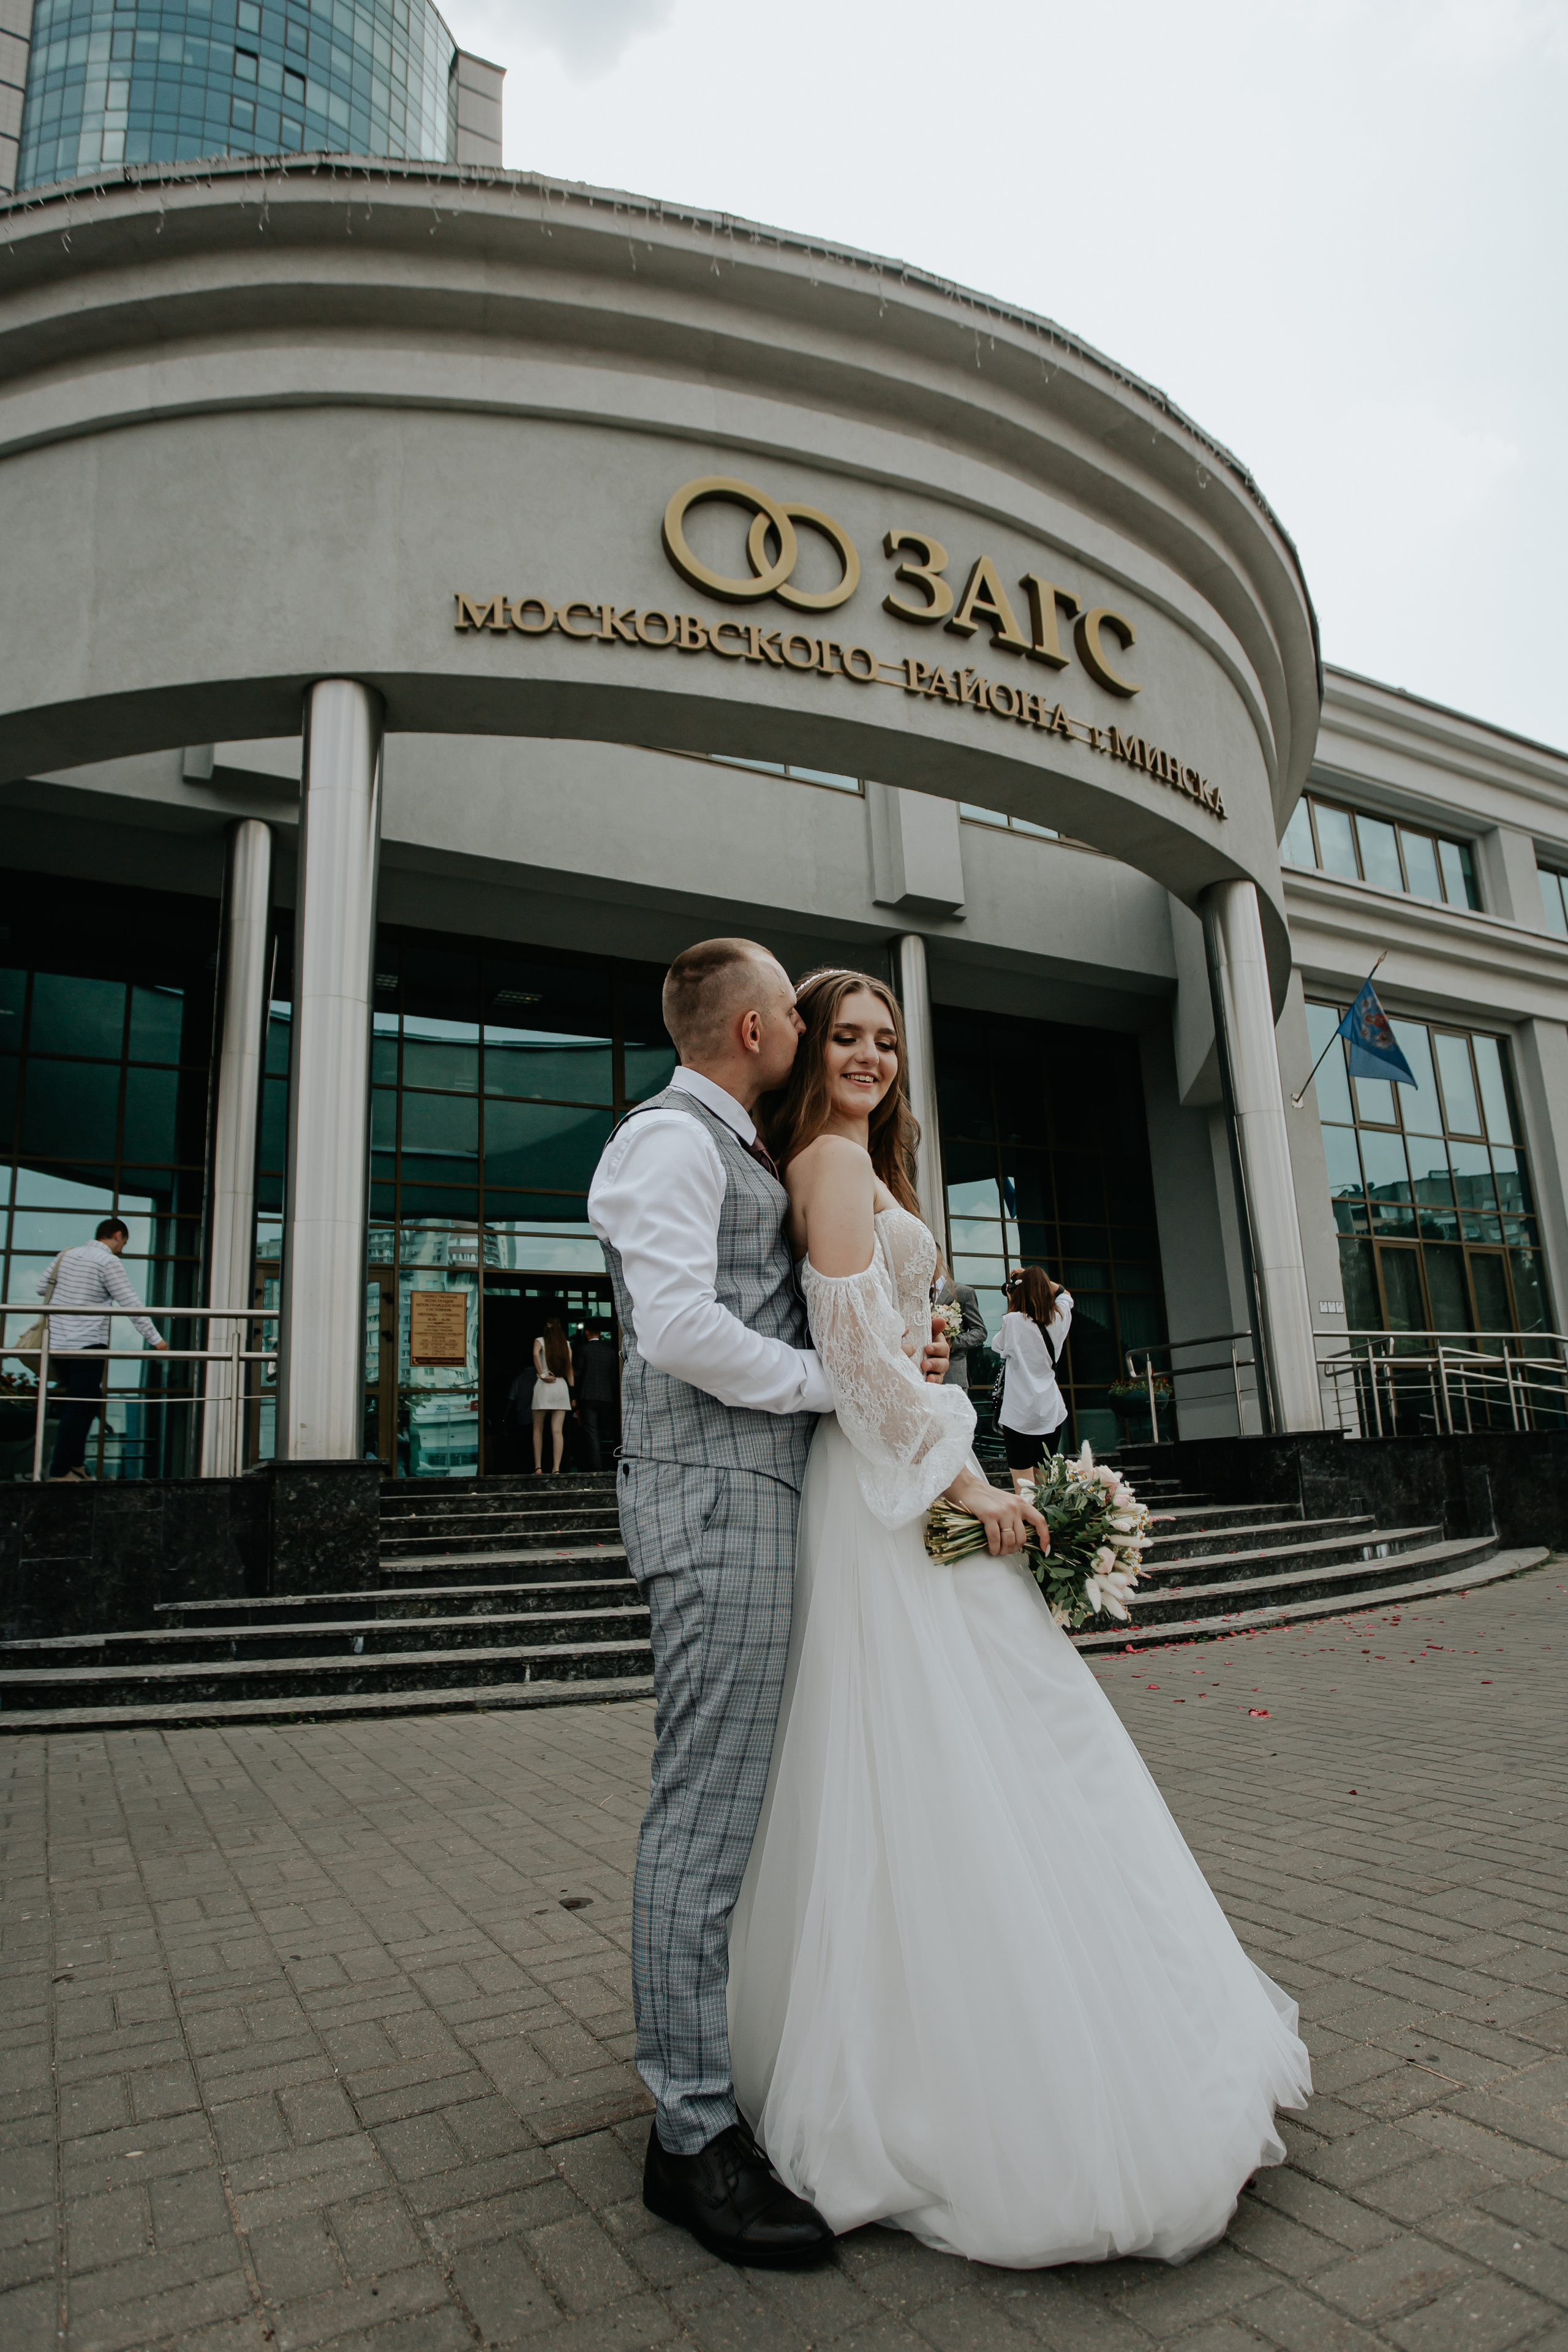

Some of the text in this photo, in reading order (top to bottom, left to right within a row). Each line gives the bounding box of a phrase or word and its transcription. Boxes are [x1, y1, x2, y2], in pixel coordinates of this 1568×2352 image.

[454, 593, 880, 681] МОСКОВСКОГО
[903, 658, 1076, 739] РАЙОНА
[882, 529, 1143, 698] ЗАГС
